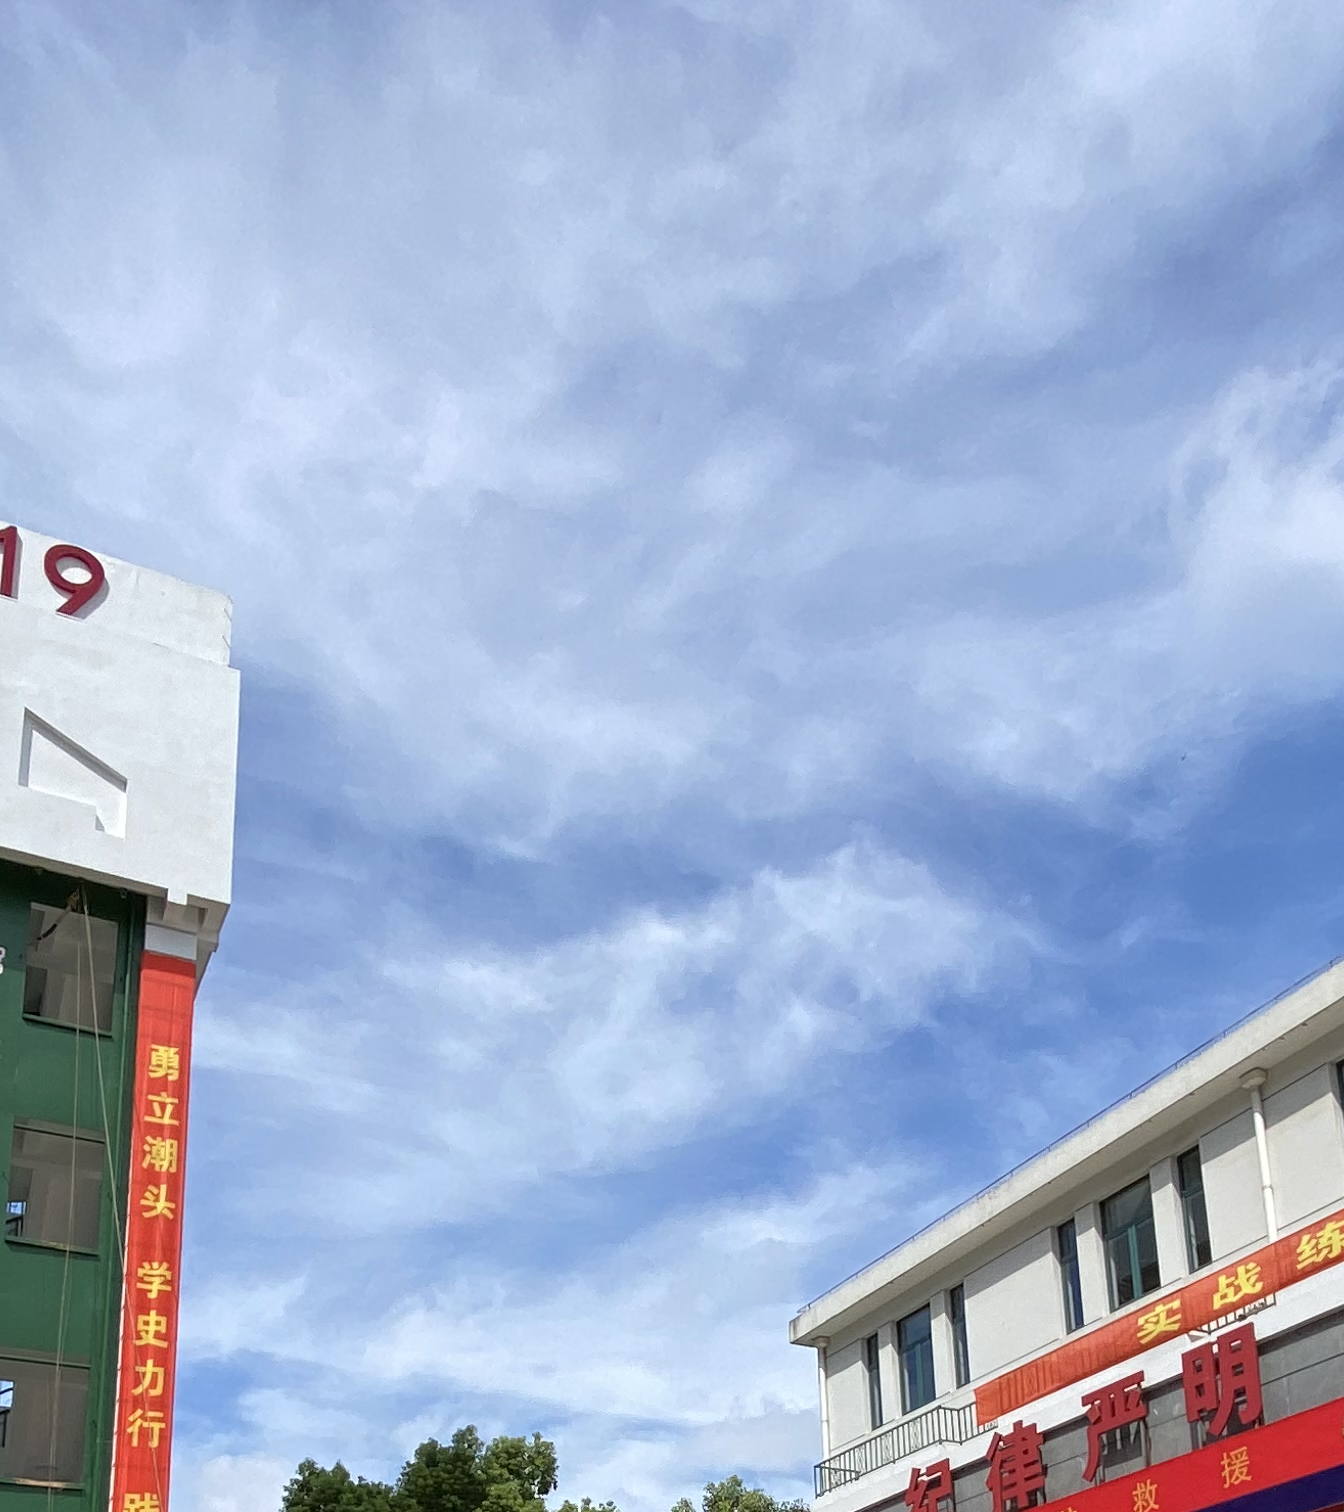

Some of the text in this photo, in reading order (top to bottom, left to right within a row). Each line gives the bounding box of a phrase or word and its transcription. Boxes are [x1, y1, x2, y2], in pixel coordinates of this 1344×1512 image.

[140, 1044, 180, 1222] 勇立潮头
[126, 1261, 172, 1449] 学史力行
